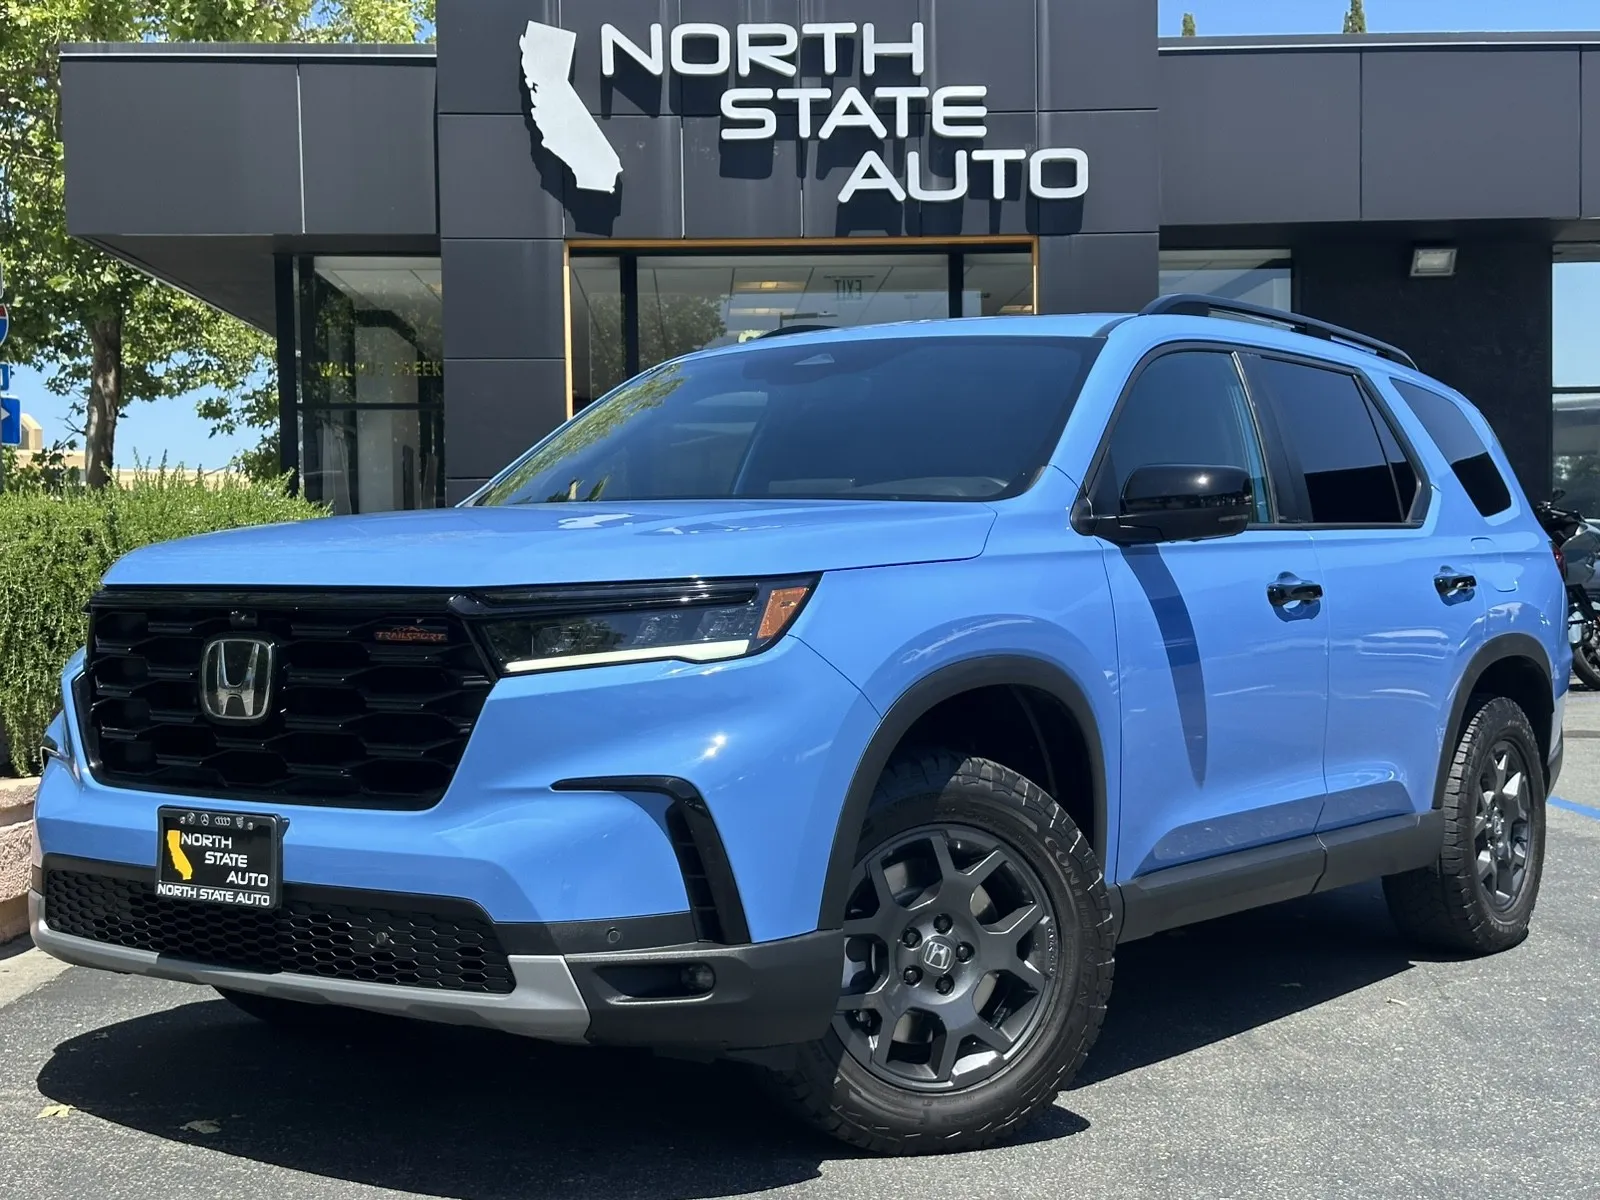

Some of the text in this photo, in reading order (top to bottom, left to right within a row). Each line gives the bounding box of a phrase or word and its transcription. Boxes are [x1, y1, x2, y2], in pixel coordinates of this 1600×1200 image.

[600, 22, 925, 77] NORTH
[720, 85, 988, 140] STATE
[837, 147, 1090, 203] AUTO
[181, 832, 232, 849] NORTH
[204, 851, 248, 868] STATE
[226, 870, 269, 887] AUTO
[157, 883, 270, 906] NORTH STATE AUTO
